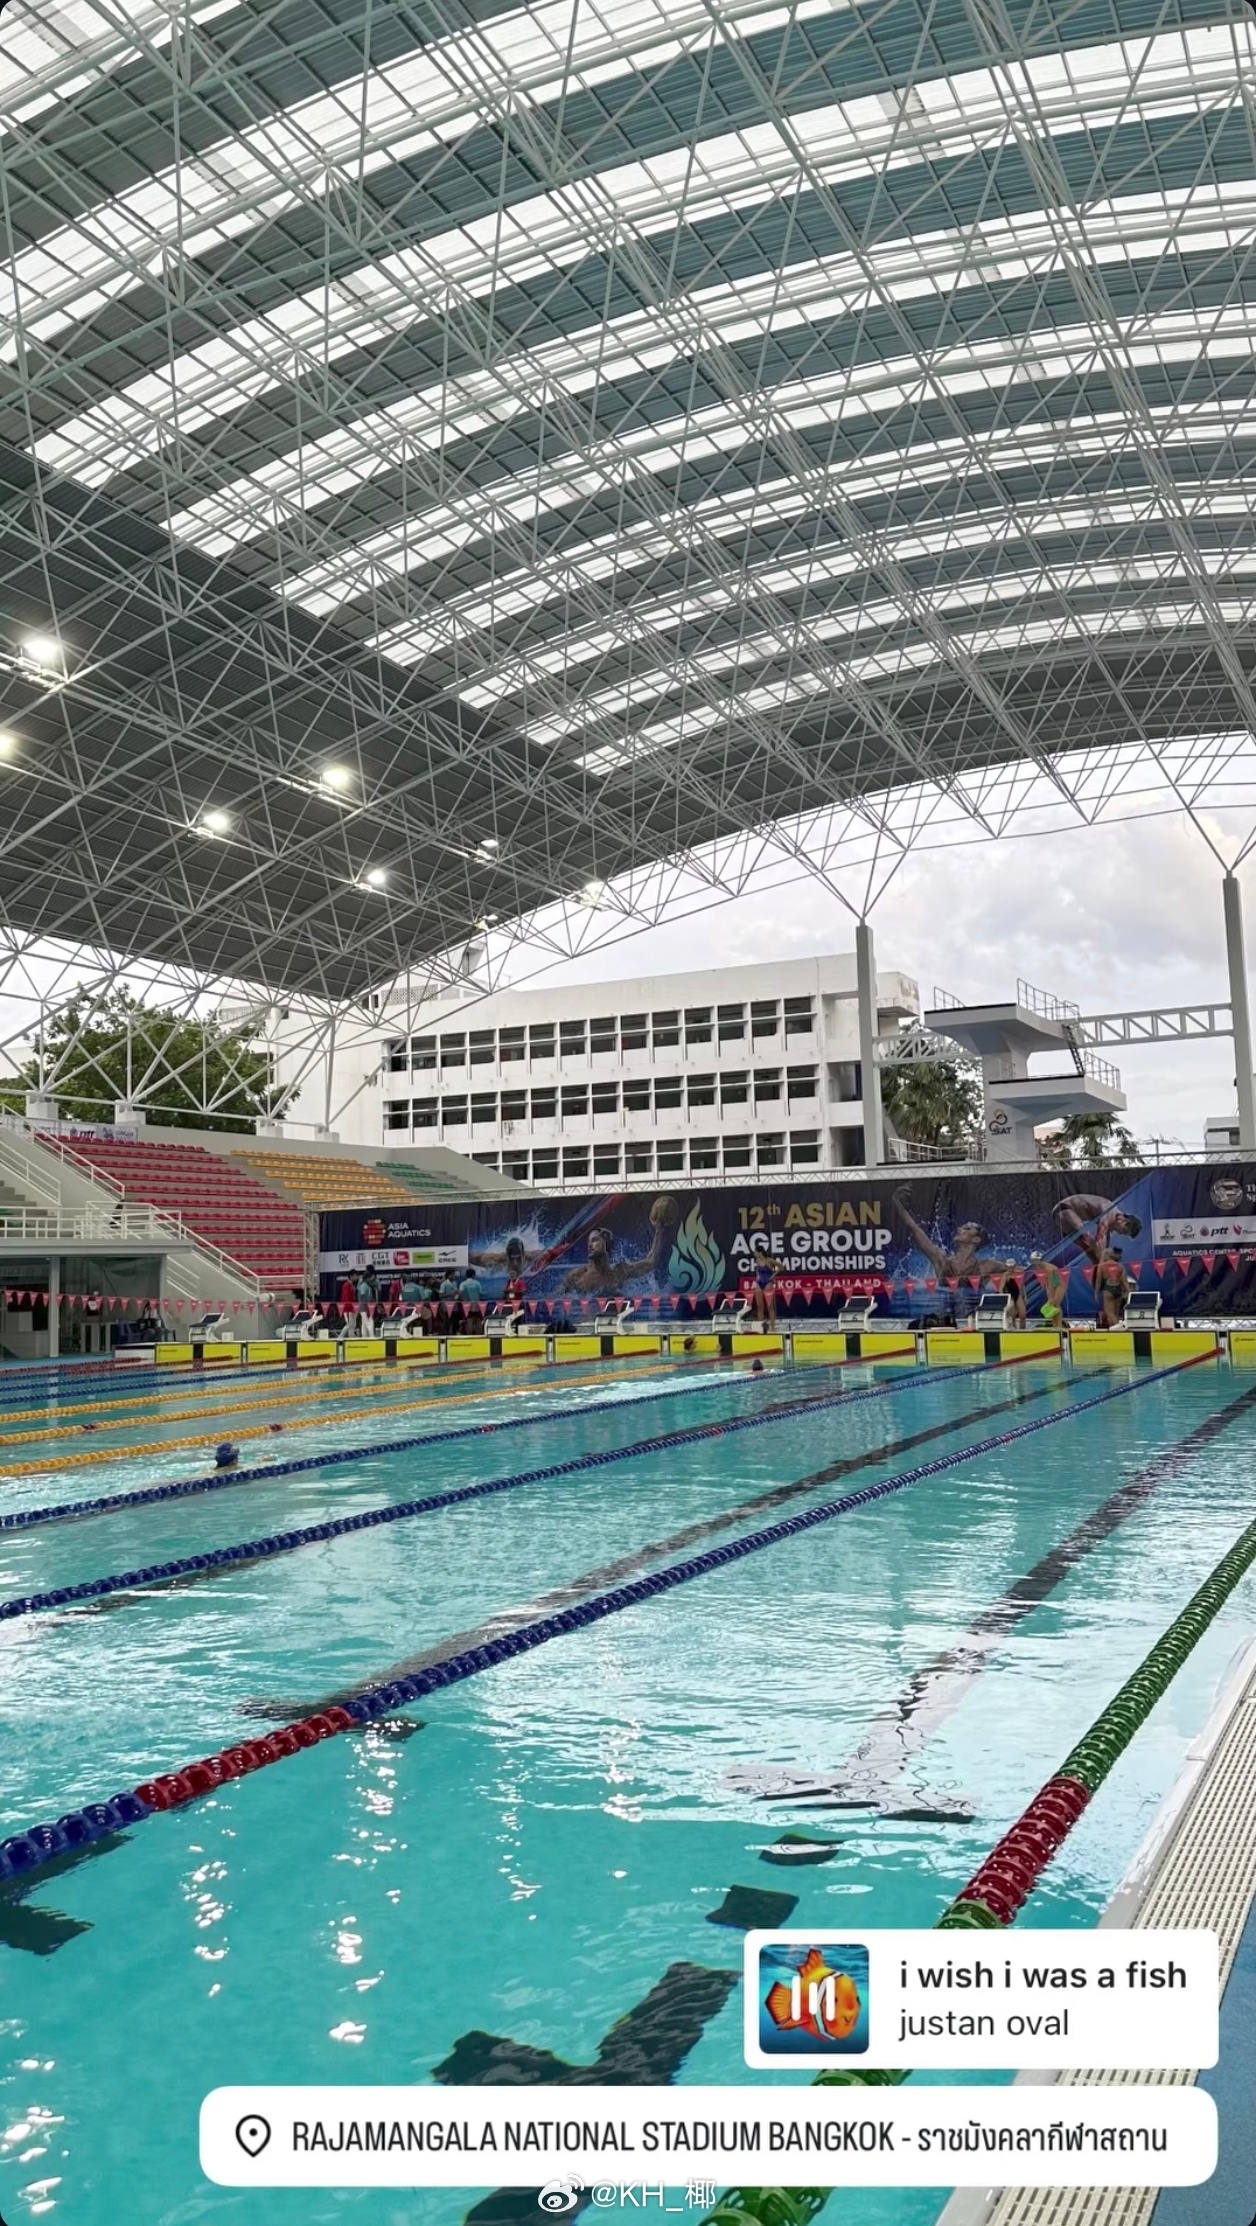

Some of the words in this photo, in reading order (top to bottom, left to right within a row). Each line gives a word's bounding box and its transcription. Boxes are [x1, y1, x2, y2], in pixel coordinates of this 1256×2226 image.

[991, 1126, 1013, 1135] SAT
[738, 1203, 781, 1230] 12th
[784, 1200, 881, 1228] ASIAN
[388, 1222, 409, 1230] ASIA
[388, 1229, 431, 1238] AQUATICS
[1210, 1227, 1229, 1237] ptt
[730, 1231, 785, 1256] AGE
[790, 1228, 893, 1254] GROUP
[737, 1254, 887, 1273] CHMPIONSHIPS
